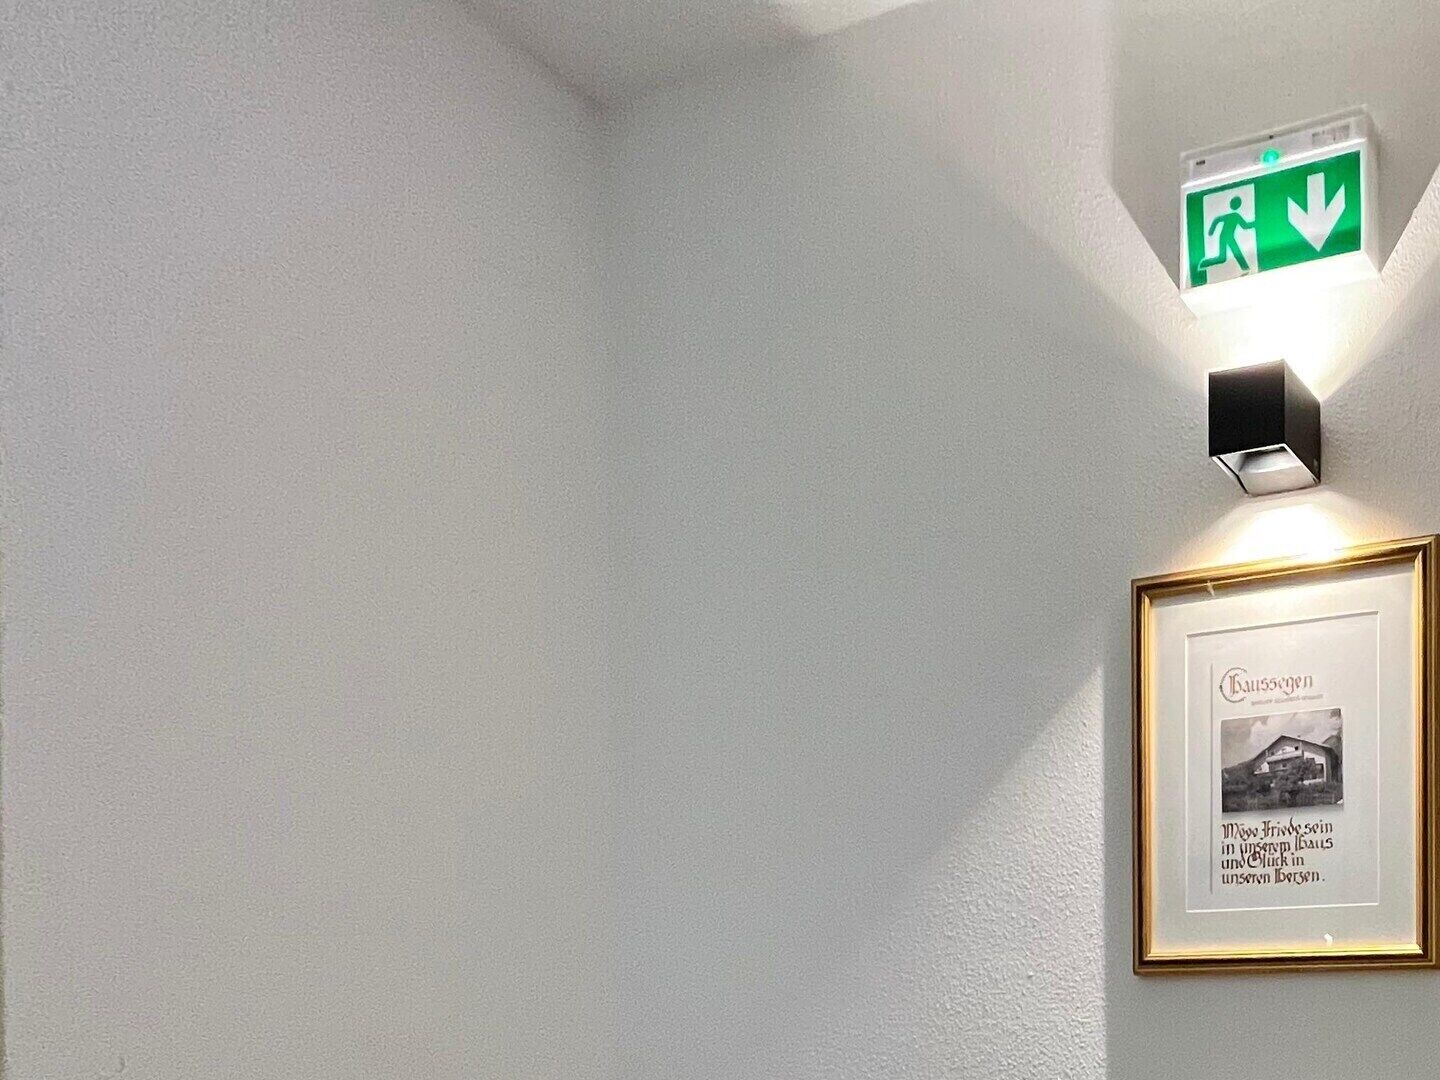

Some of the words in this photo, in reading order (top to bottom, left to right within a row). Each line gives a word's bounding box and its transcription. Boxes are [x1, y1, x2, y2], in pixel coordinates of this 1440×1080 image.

[1222, 822, 1258, 841] Möge
[1261, 817, 1301, 840] Friede
[1304, 819, 1333, 835] sein
[1221, 841, 1235, 855] in
[1240, 841, 1291, 855] unserem
[1295, 834, 1333, 852] Haus
[1221, 850, 1246, 869] und
[1247, 851, 1289, 868] Glück
[1291, 853, 1304, 866] in
[1221, 873, 1271, 885] unseren
